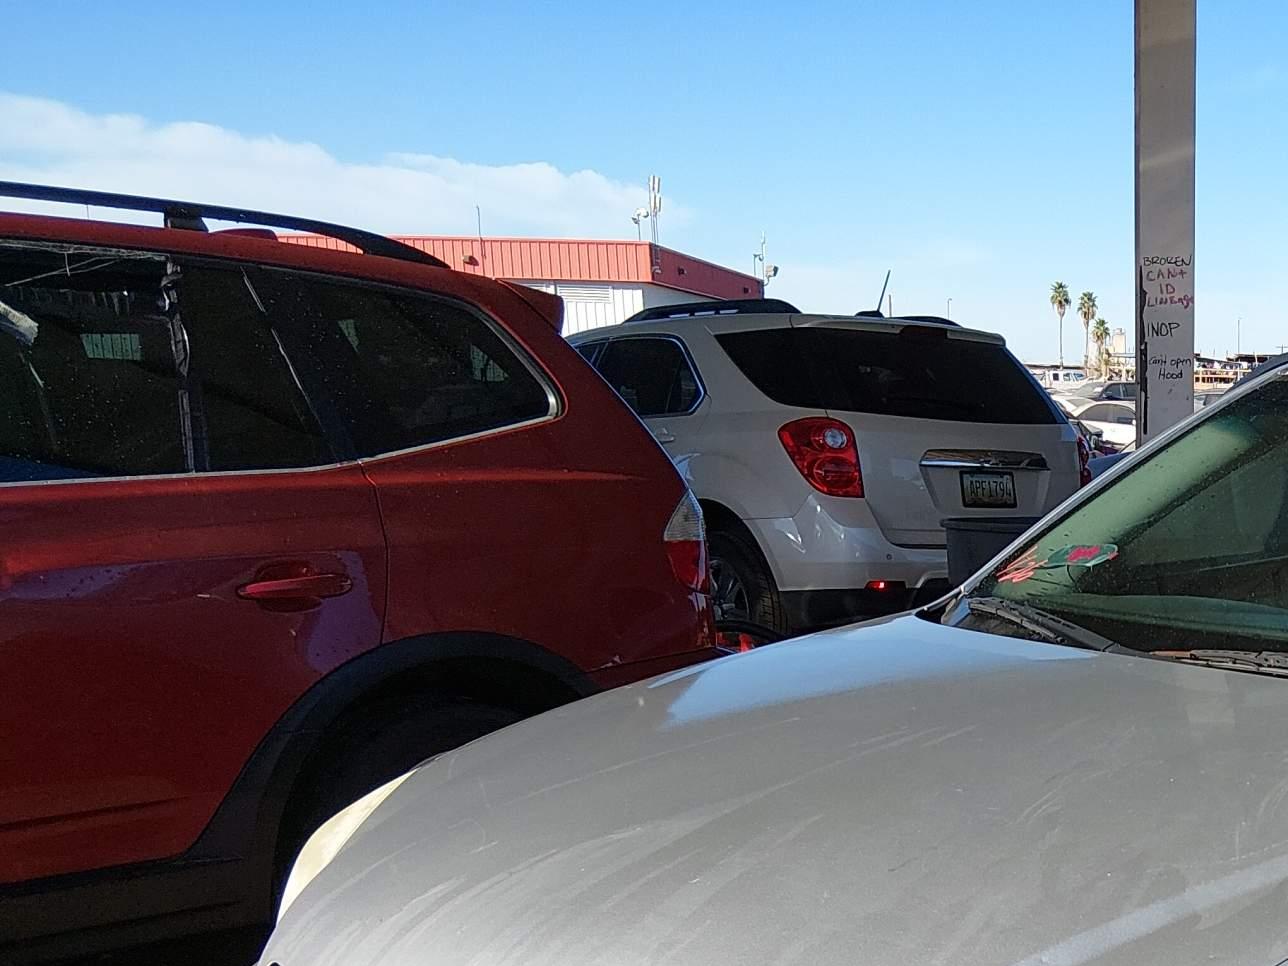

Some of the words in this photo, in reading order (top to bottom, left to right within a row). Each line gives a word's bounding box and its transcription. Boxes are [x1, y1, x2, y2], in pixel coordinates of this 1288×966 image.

[1143, 254, 1192, 267] BROKEN
[1159, 283, 1176, 295] ID
[1147, 322, 1180, 338] INOP
[1170, 358, 1192, 369] open
[1158, 367, 1183, 380] Hood
